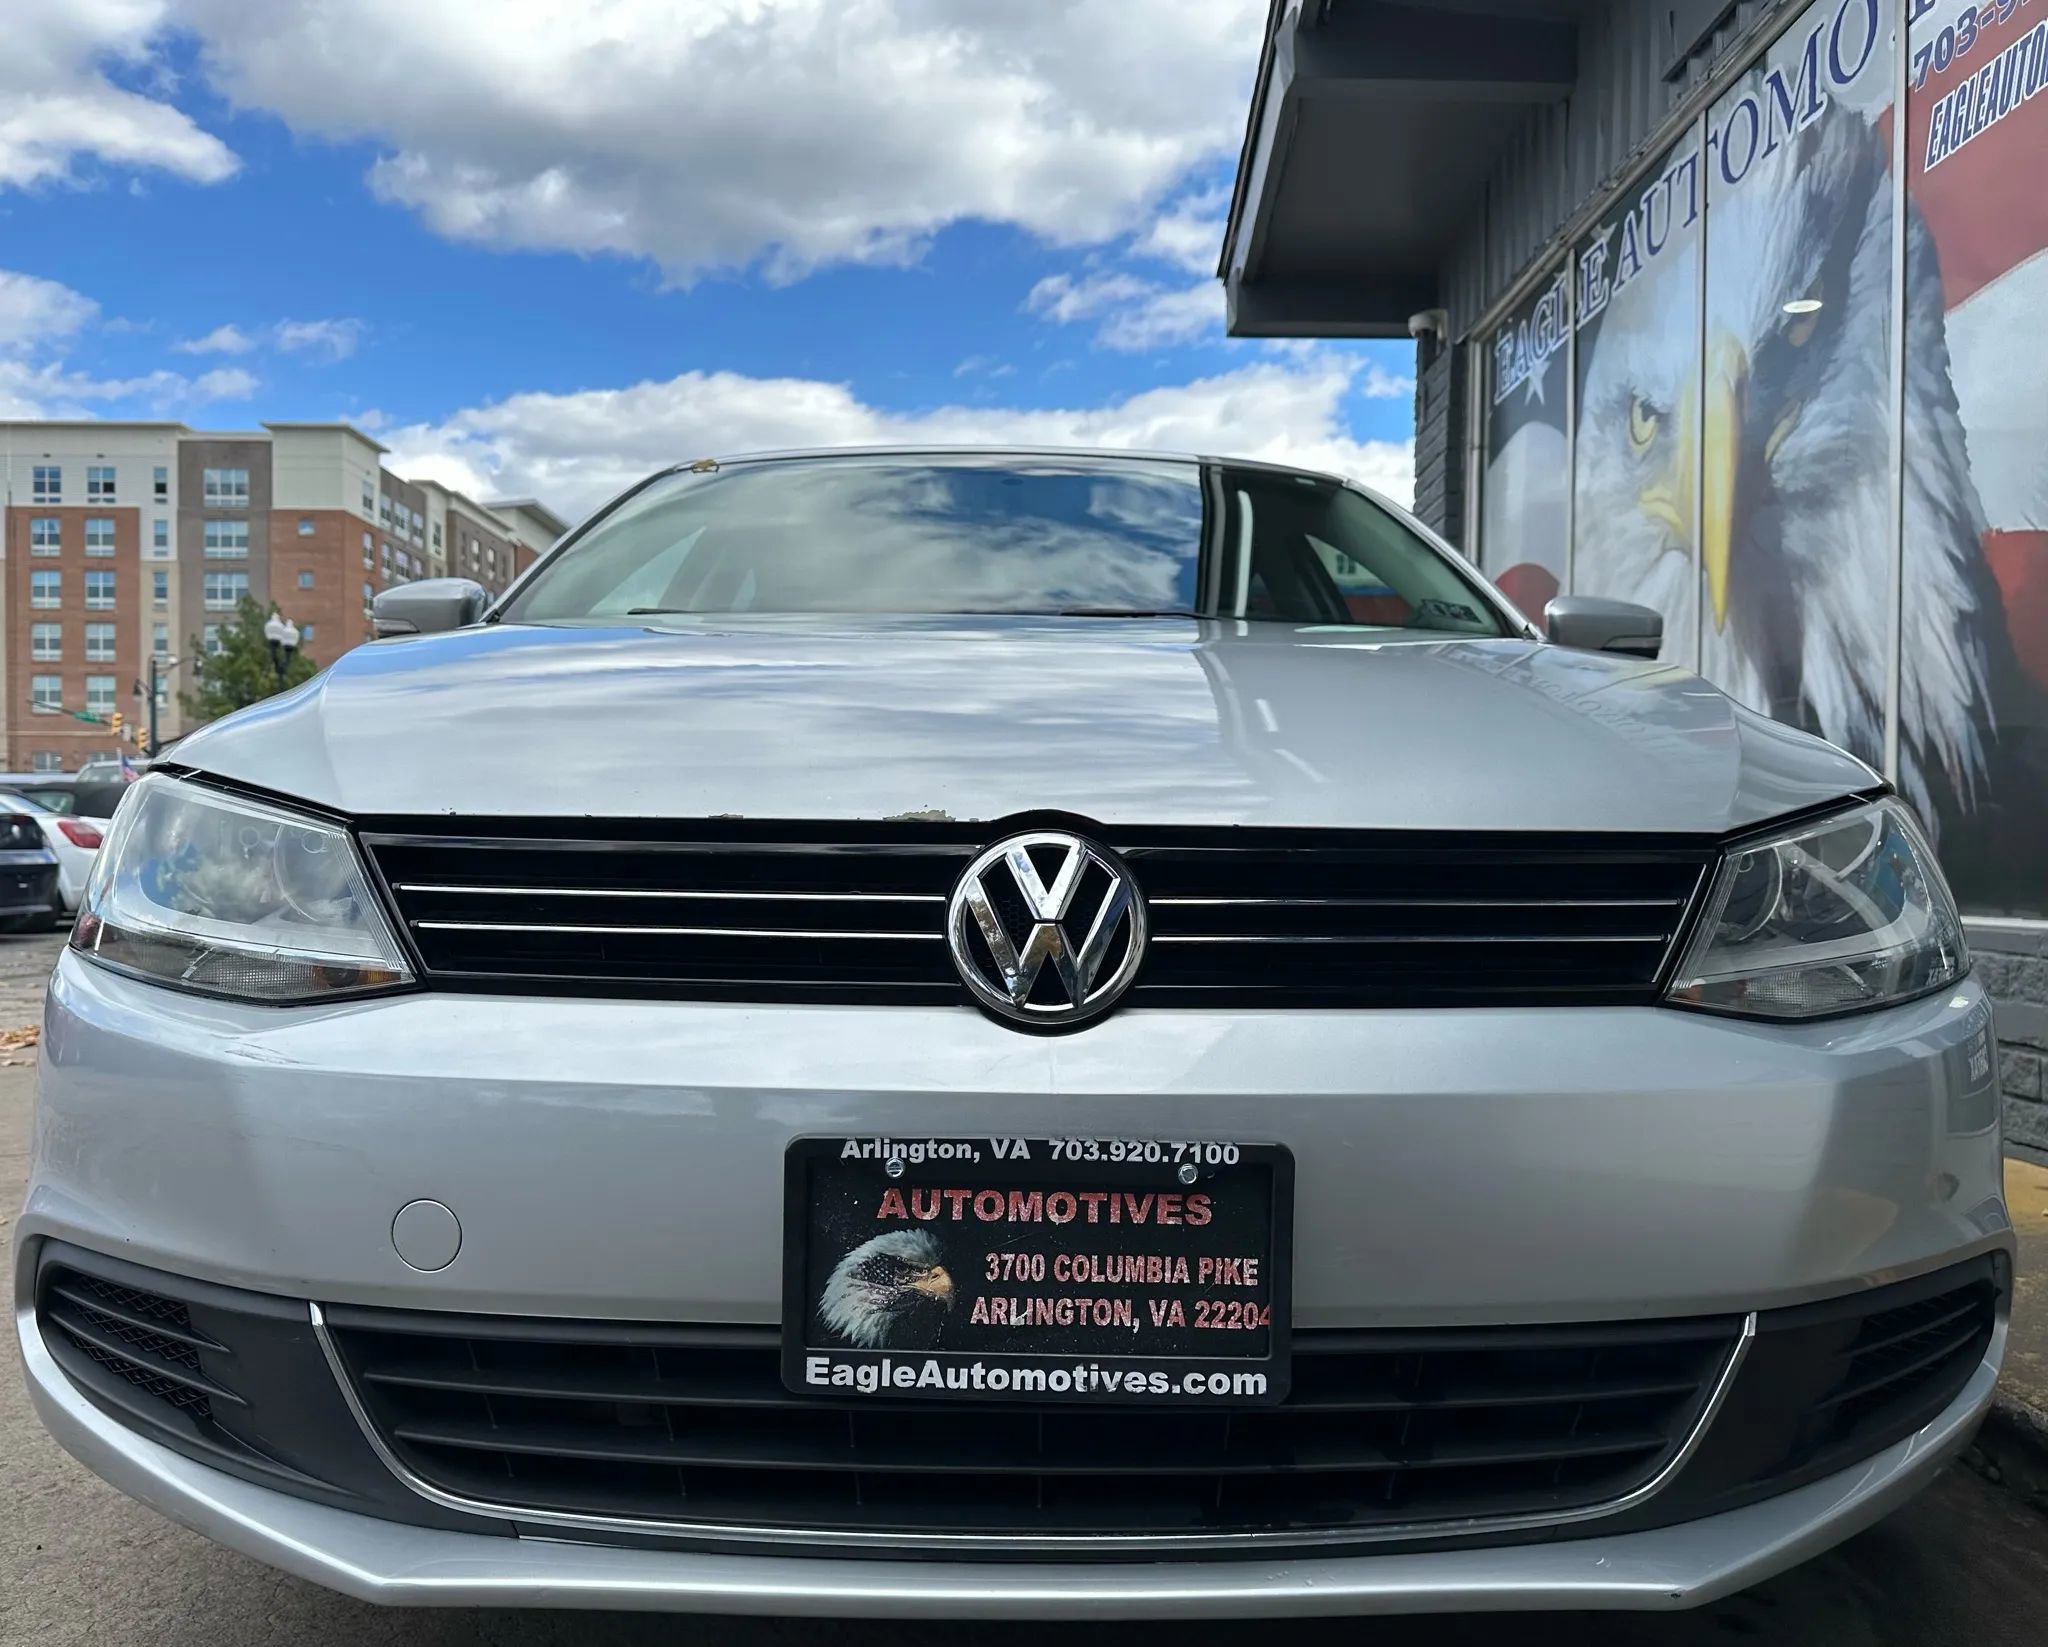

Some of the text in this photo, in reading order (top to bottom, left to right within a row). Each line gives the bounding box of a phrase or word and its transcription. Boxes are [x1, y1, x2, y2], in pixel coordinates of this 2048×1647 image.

[1494, 237, 1610, 405] EAGLE
[841, 1137, 1240, 1165] Arlington, VA 703.920.7100
[877, 1187, 1213, 1226] AUTOMOTIVES
[985, 1253, 1259, 1286] 3700 COLUMBIA PIKE
[970, 1296, 1140, 1334] ARLINGTON,
[1149, 1299, 1186, 1328] VA
[805, 1356, 1268, 1396] EagleAutomotives.com
